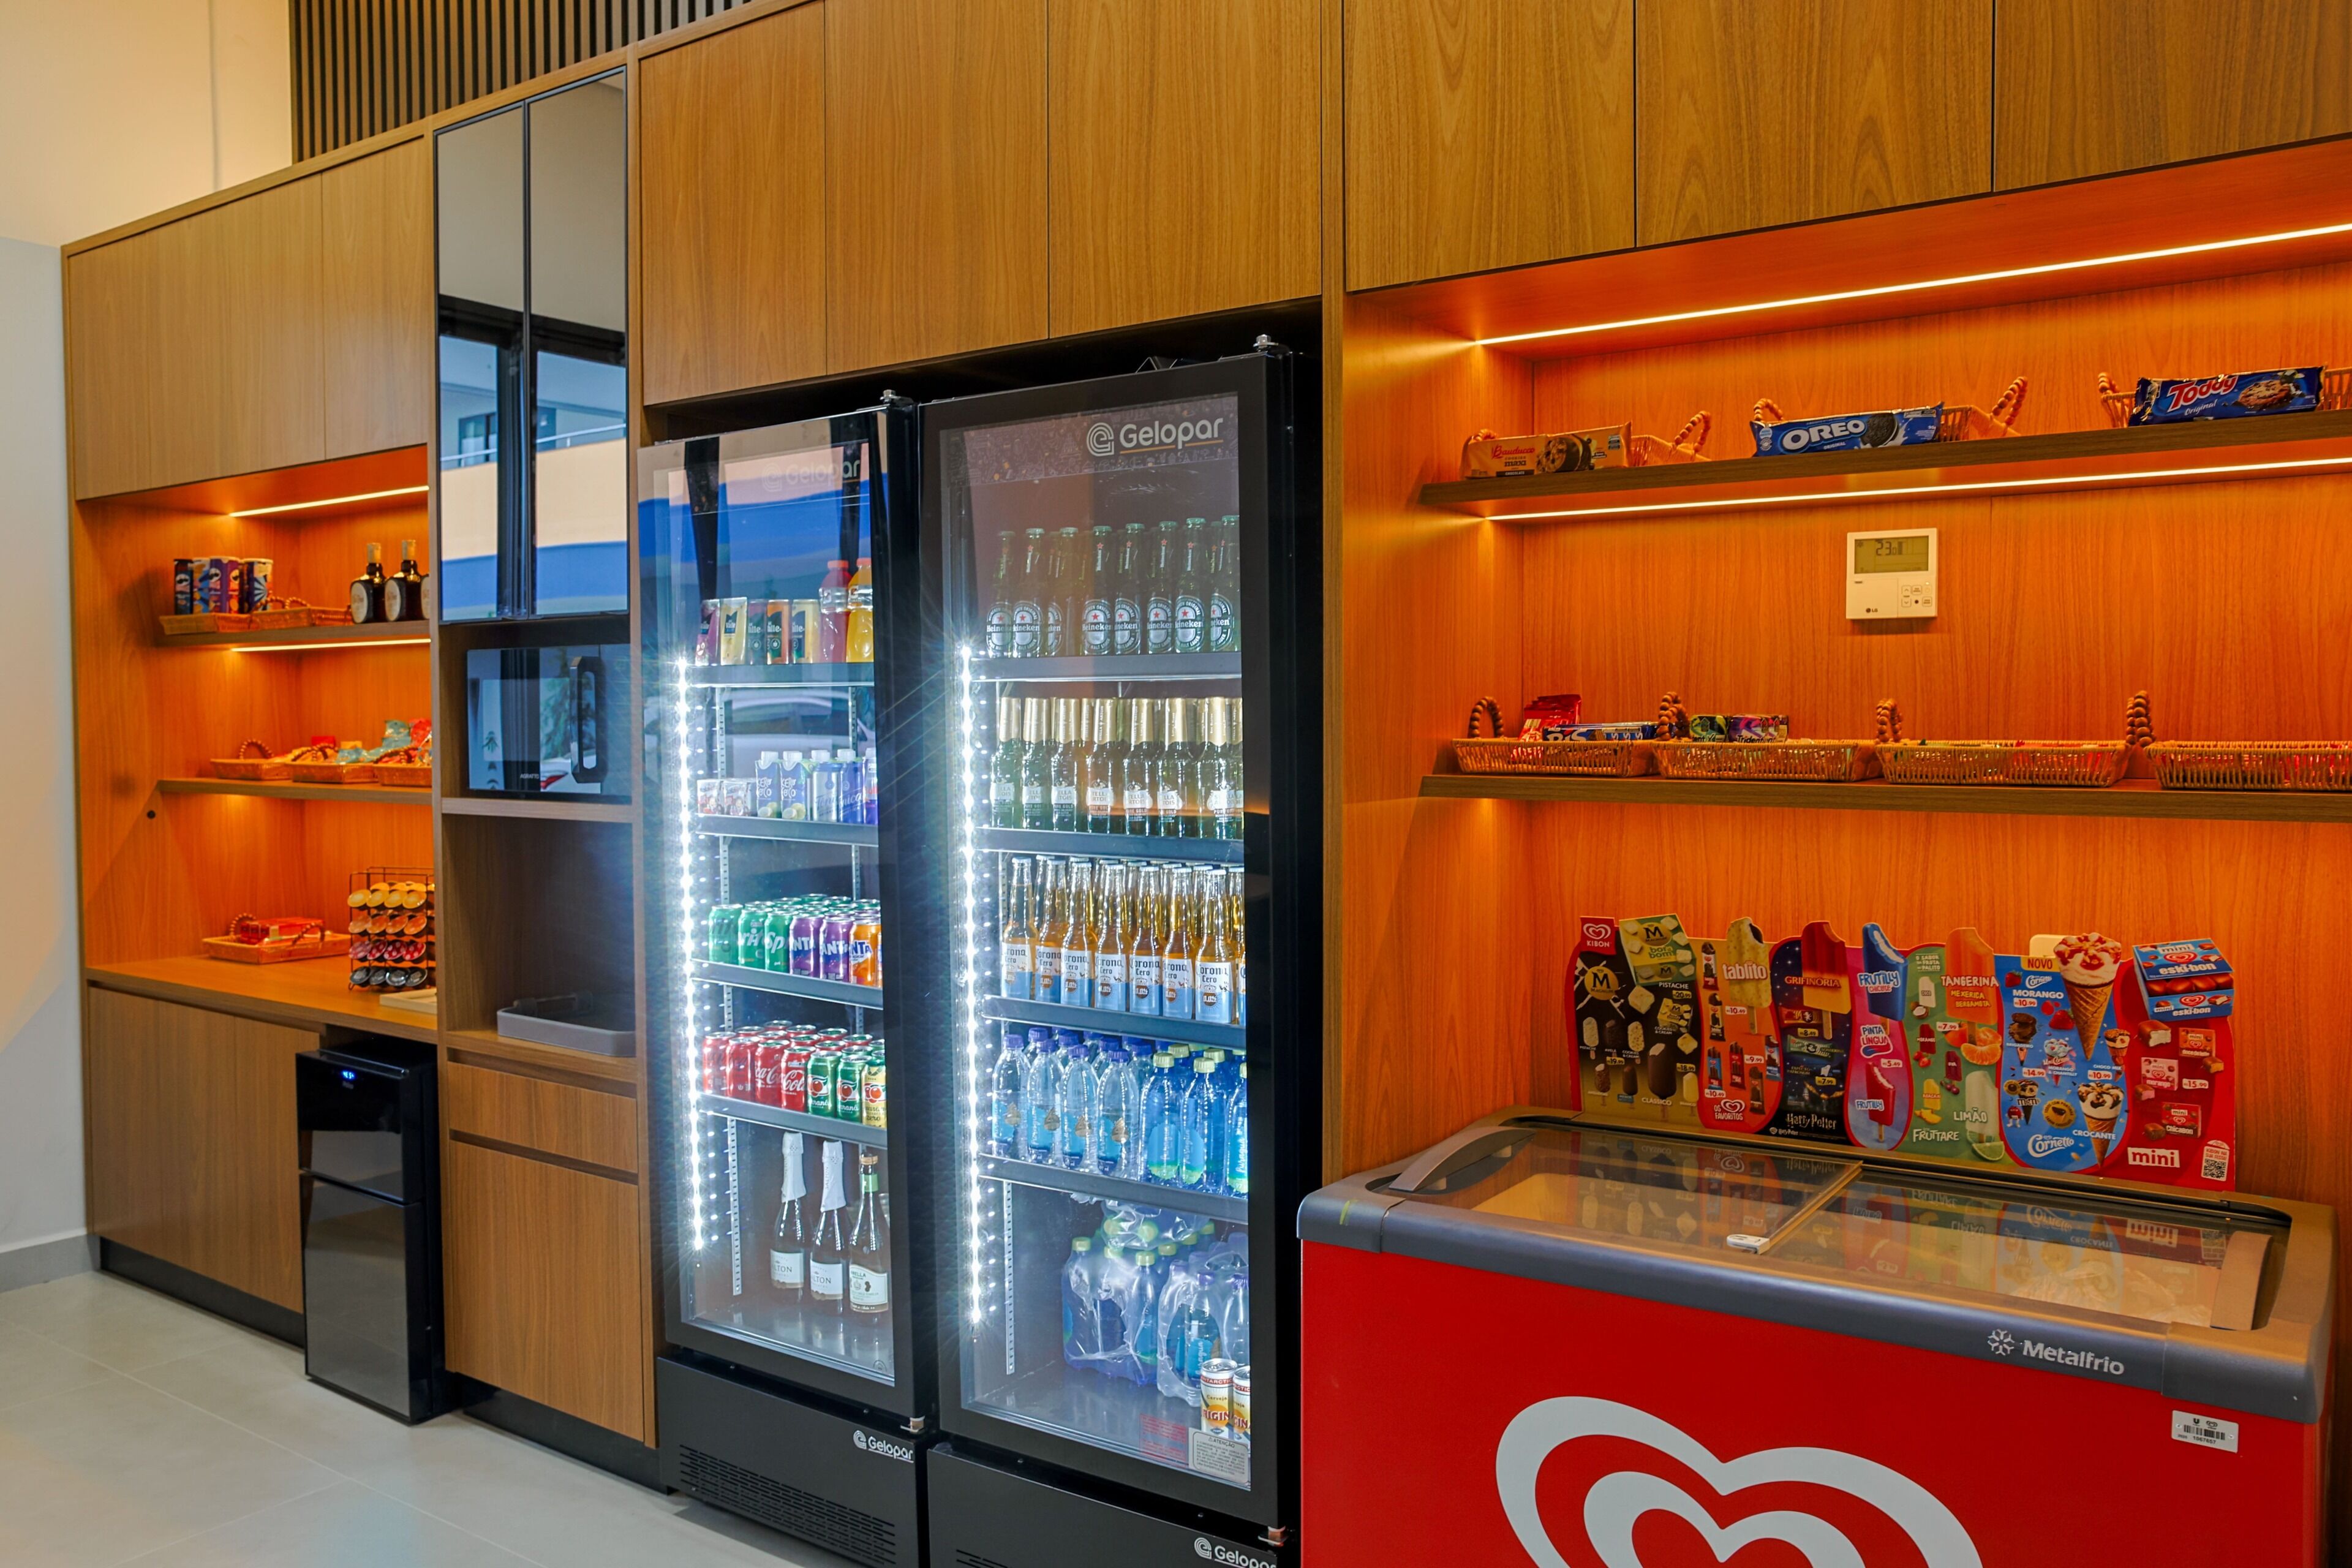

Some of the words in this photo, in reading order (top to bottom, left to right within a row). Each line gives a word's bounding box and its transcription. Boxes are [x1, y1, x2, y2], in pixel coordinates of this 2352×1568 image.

[2167, 375, 2239, 413] Toddy
[2185, 399, 2217, 416] Original
[1120, 418, 1223, 449] Gelopar
[1782, 420, 1865, 450] OREO
[1492, 443, 1535, 459] Bauducco
[786, 460, 860, 486] Gelopar
[1644, 926, 1664, 939] M
[1722, 961, 1768, 981] tablito
[2028, 959, 2052, 970] NOVO
[1592, 972, 1611, 989] M
[1940, 976, 1999, 987] TANGERINA
[1951, 990, 1985, 999] MEXERICA
[2013, 990, 2064, 999] MORANGO
[1642, 1097, 1672, 1106] CLÁSSICO
[1786, 1113, 1810, 1128] Harry
[1811, 1114, 1837, 1129] Potter
[1953, 1107, 1988, 1122] LIMÃO
[1913, 1128, 1959, 1142] FRUTTARE
[2073, 1130, 2116, 1139] CROCANTE
[2028, 1134, 2075, 1158] Cornetto
[2132, 1150, 2175, 1166] mini
[2022, 1340, 2125, 1375] Metalfrio
[868, 1436, 913, 1459] Gelopar
